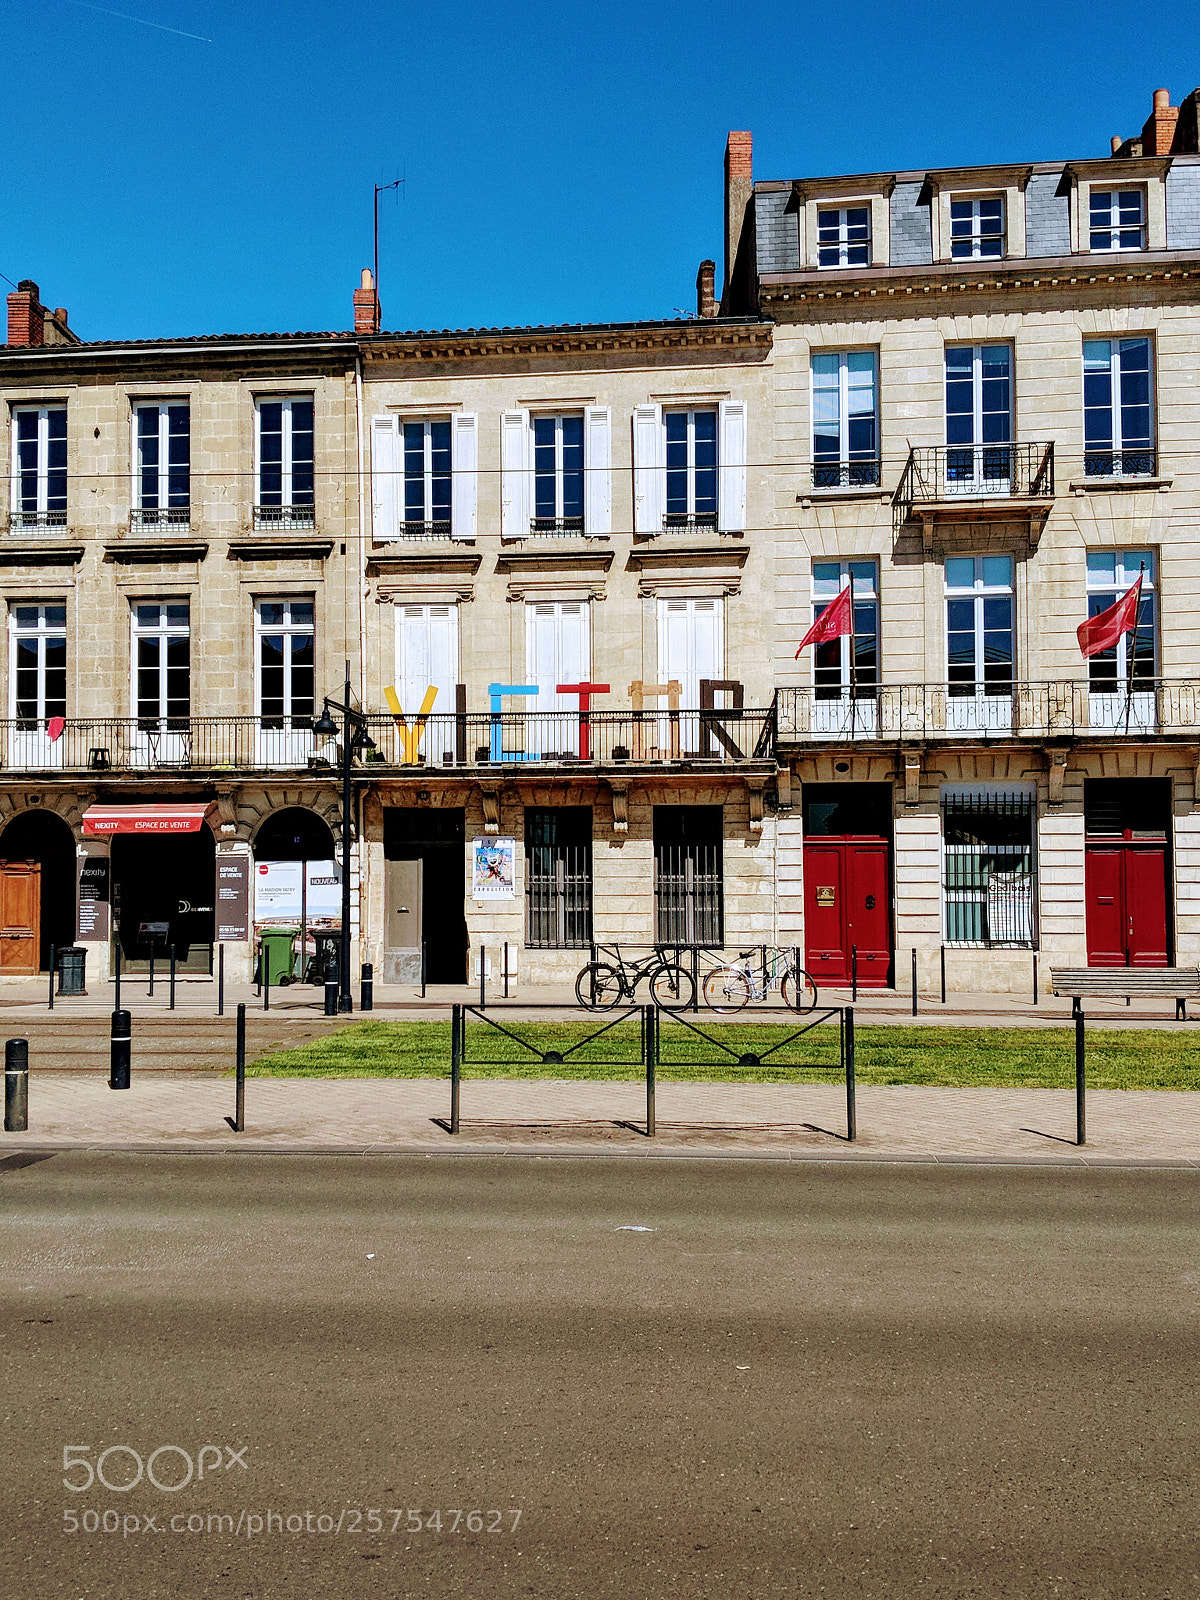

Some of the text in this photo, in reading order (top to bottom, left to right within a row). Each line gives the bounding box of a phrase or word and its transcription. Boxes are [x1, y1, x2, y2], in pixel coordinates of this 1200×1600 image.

[134, 821, 158, 829] ESPACE
[80, 868, 106, 877] nexity
[322, 938, 335, 950] 18
